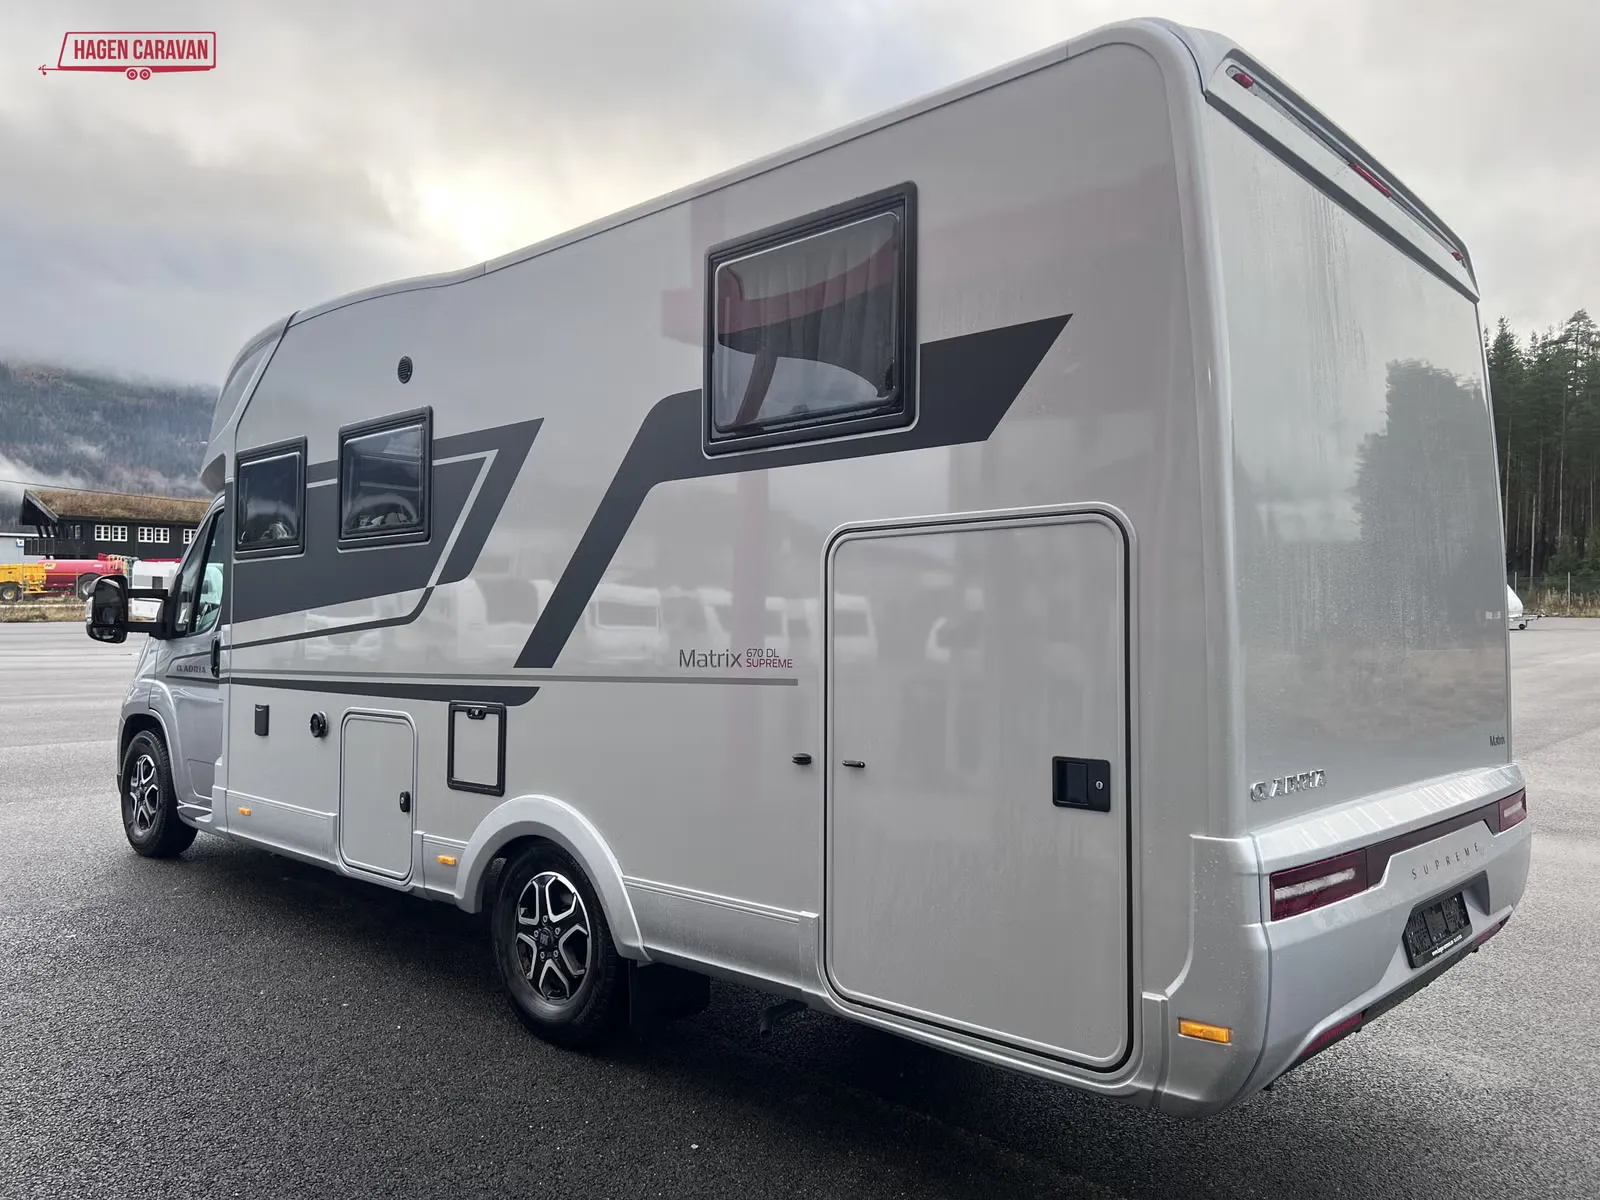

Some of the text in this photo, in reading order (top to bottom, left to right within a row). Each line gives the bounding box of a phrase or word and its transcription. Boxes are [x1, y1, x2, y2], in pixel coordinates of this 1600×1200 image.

[679, 648, 780, 668] Matrix 670 DL
[746, 659, 793, 668] SUPREME
[183, 664, 206, 673] ADRIA
[1411, 842, 1479, 880] SUPREME
